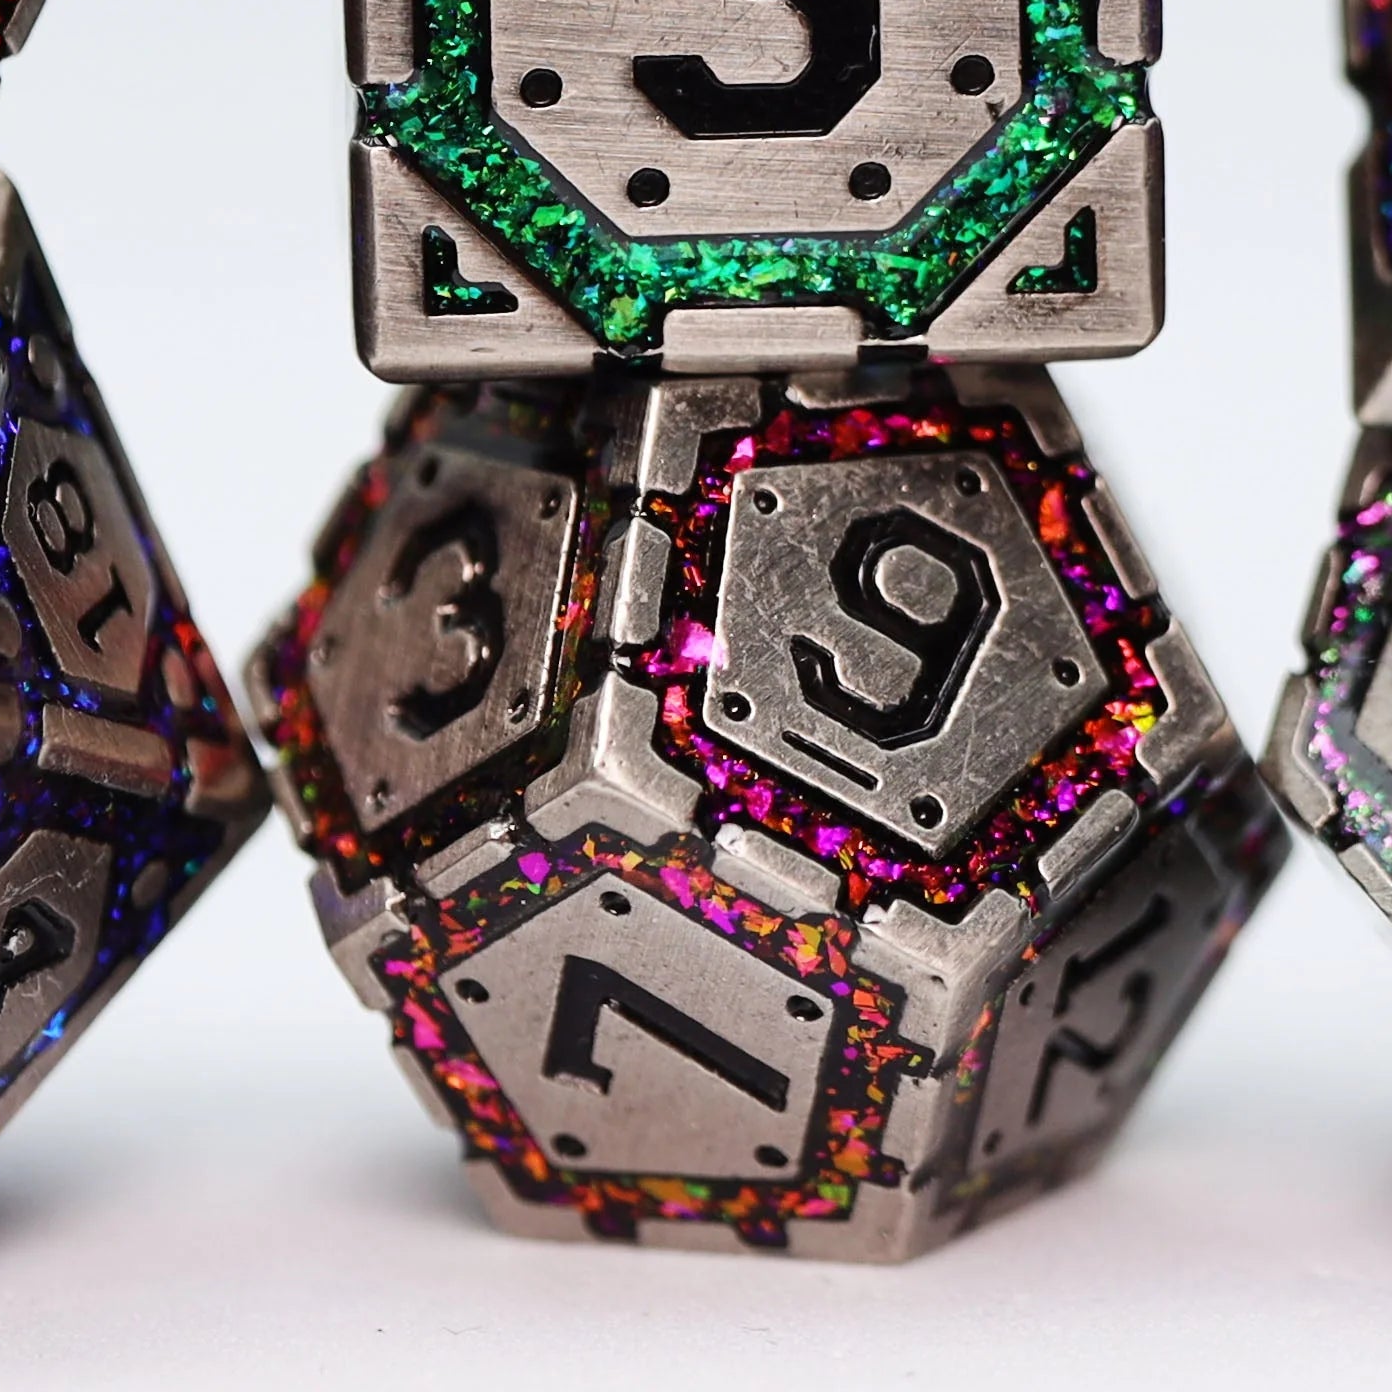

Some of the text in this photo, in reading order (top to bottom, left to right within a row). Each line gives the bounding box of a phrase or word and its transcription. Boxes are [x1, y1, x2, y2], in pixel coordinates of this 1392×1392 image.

[25, 460, 134, 654] 18
[385, 498, 508, 742] 3
[790, 504, 1004, 750] 9
[540, 952, 790, 1112] 7
[1024, 892, 1173, 1126] 12
